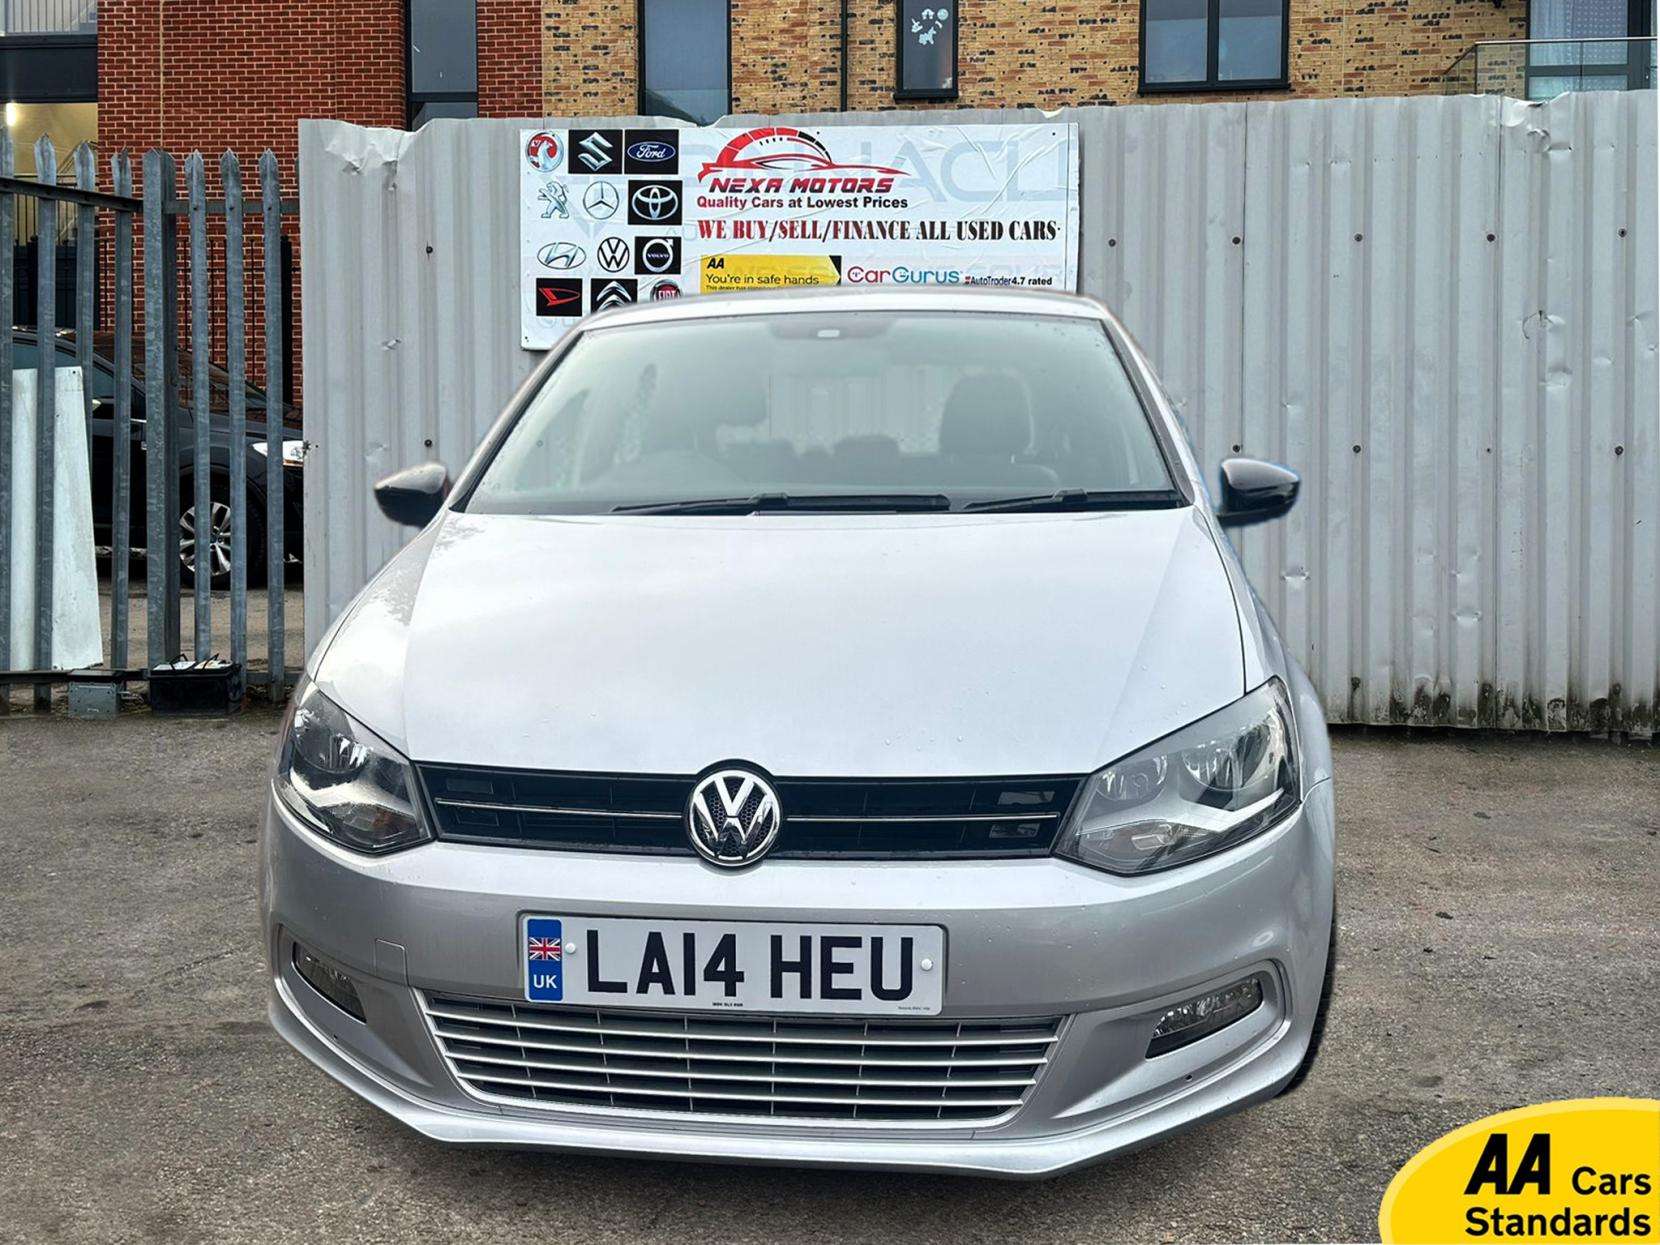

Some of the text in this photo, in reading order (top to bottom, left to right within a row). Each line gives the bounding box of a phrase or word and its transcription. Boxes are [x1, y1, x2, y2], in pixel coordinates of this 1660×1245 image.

[636, 144, 666, 159] Ford
[708, 177, 895, 194] NEXA MOTORS
[697, 196, 908, 211] Quality Cars at Lowest Prices
[697, 219, 727, 240] WE
[733, 219, 911, 243] BUY/SELL/FINANCE
[916, 220, 951, 241] ALL
[956, 220, 1004, 241] USED
[1008, 220, 1057, 241] CARS
[706, 257, 725, 270] AA
[706, 273, 820, 286] You're in safe hands
[847, 266, 960, 285] CarGurus
[1028, 276, 1053, 286] rated
[586, 929, 914, 1002] LA14 HEU
[533, 974, 557, 989] UK
